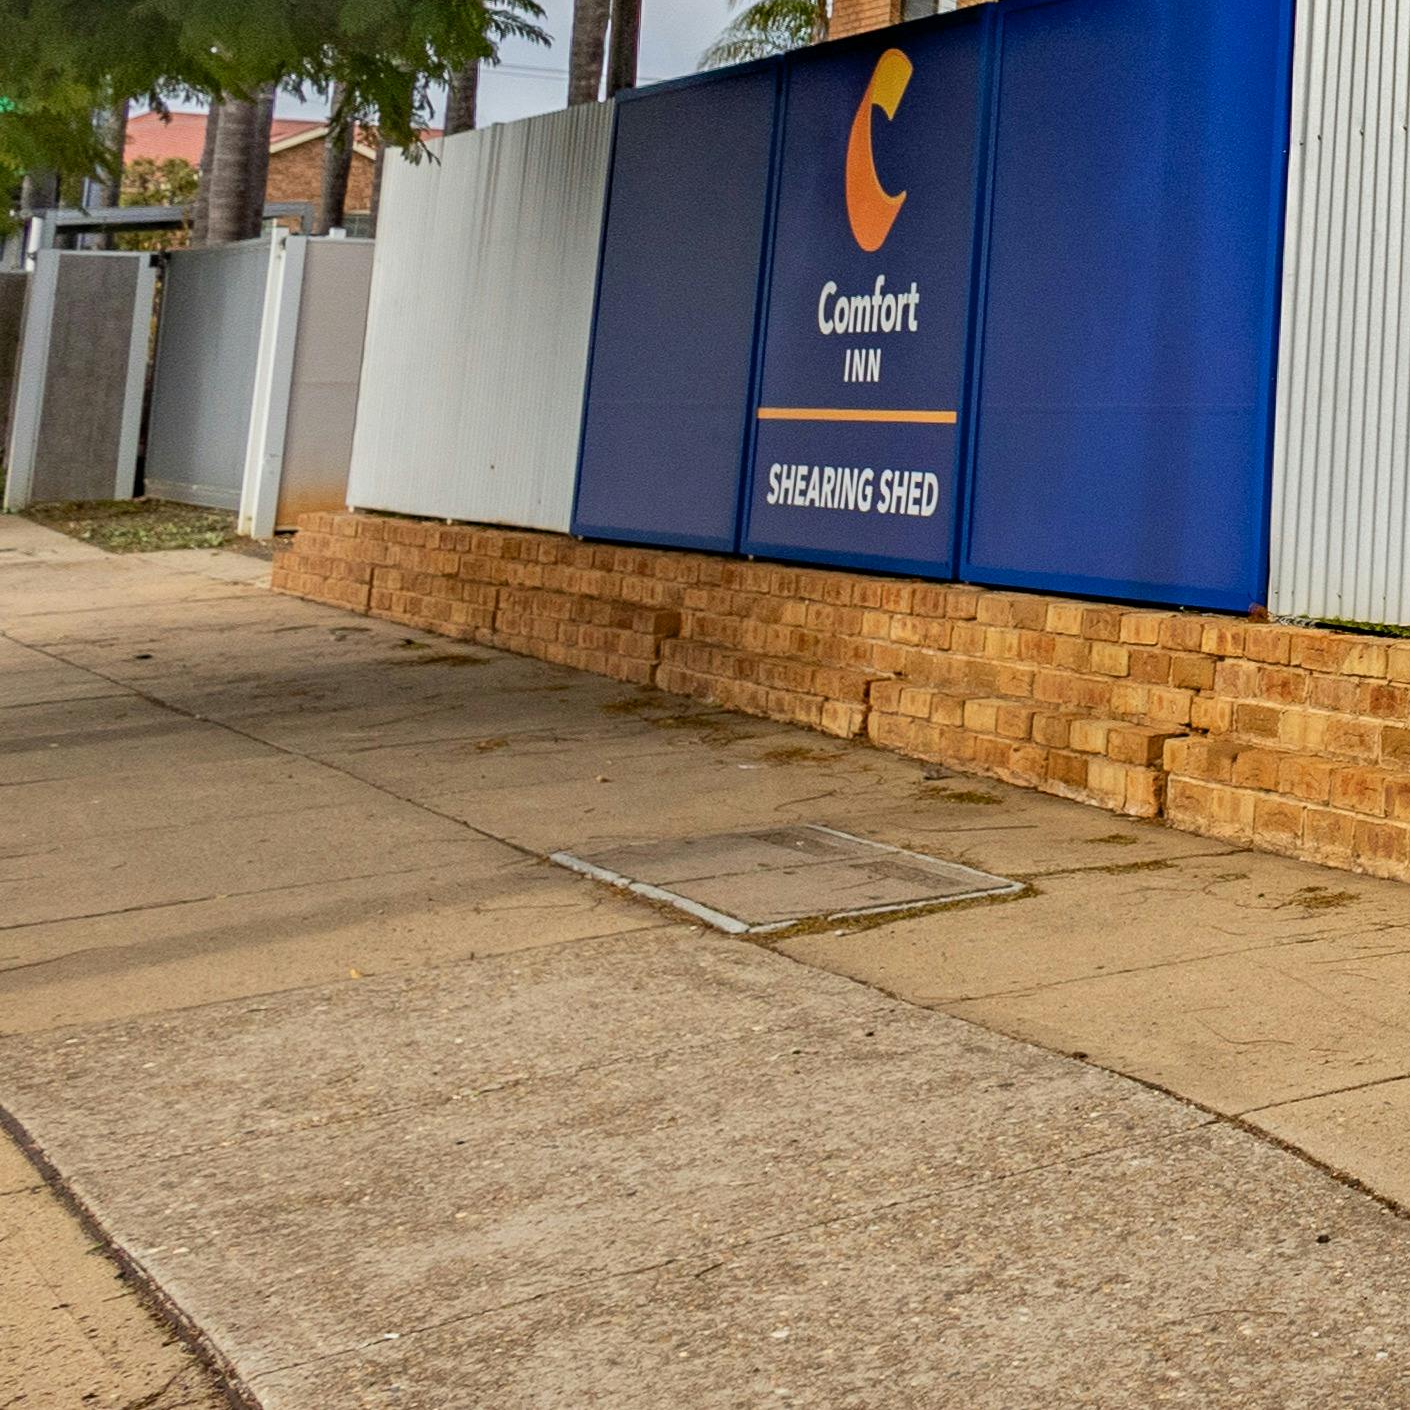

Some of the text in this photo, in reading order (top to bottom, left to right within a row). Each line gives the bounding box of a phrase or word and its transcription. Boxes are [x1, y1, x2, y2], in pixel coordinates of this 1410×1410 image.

[818, 274, 920, 335] Comfort
[843, 348, 881, 383] INN
[766, 463, 939, 517] SHEARING SHED
